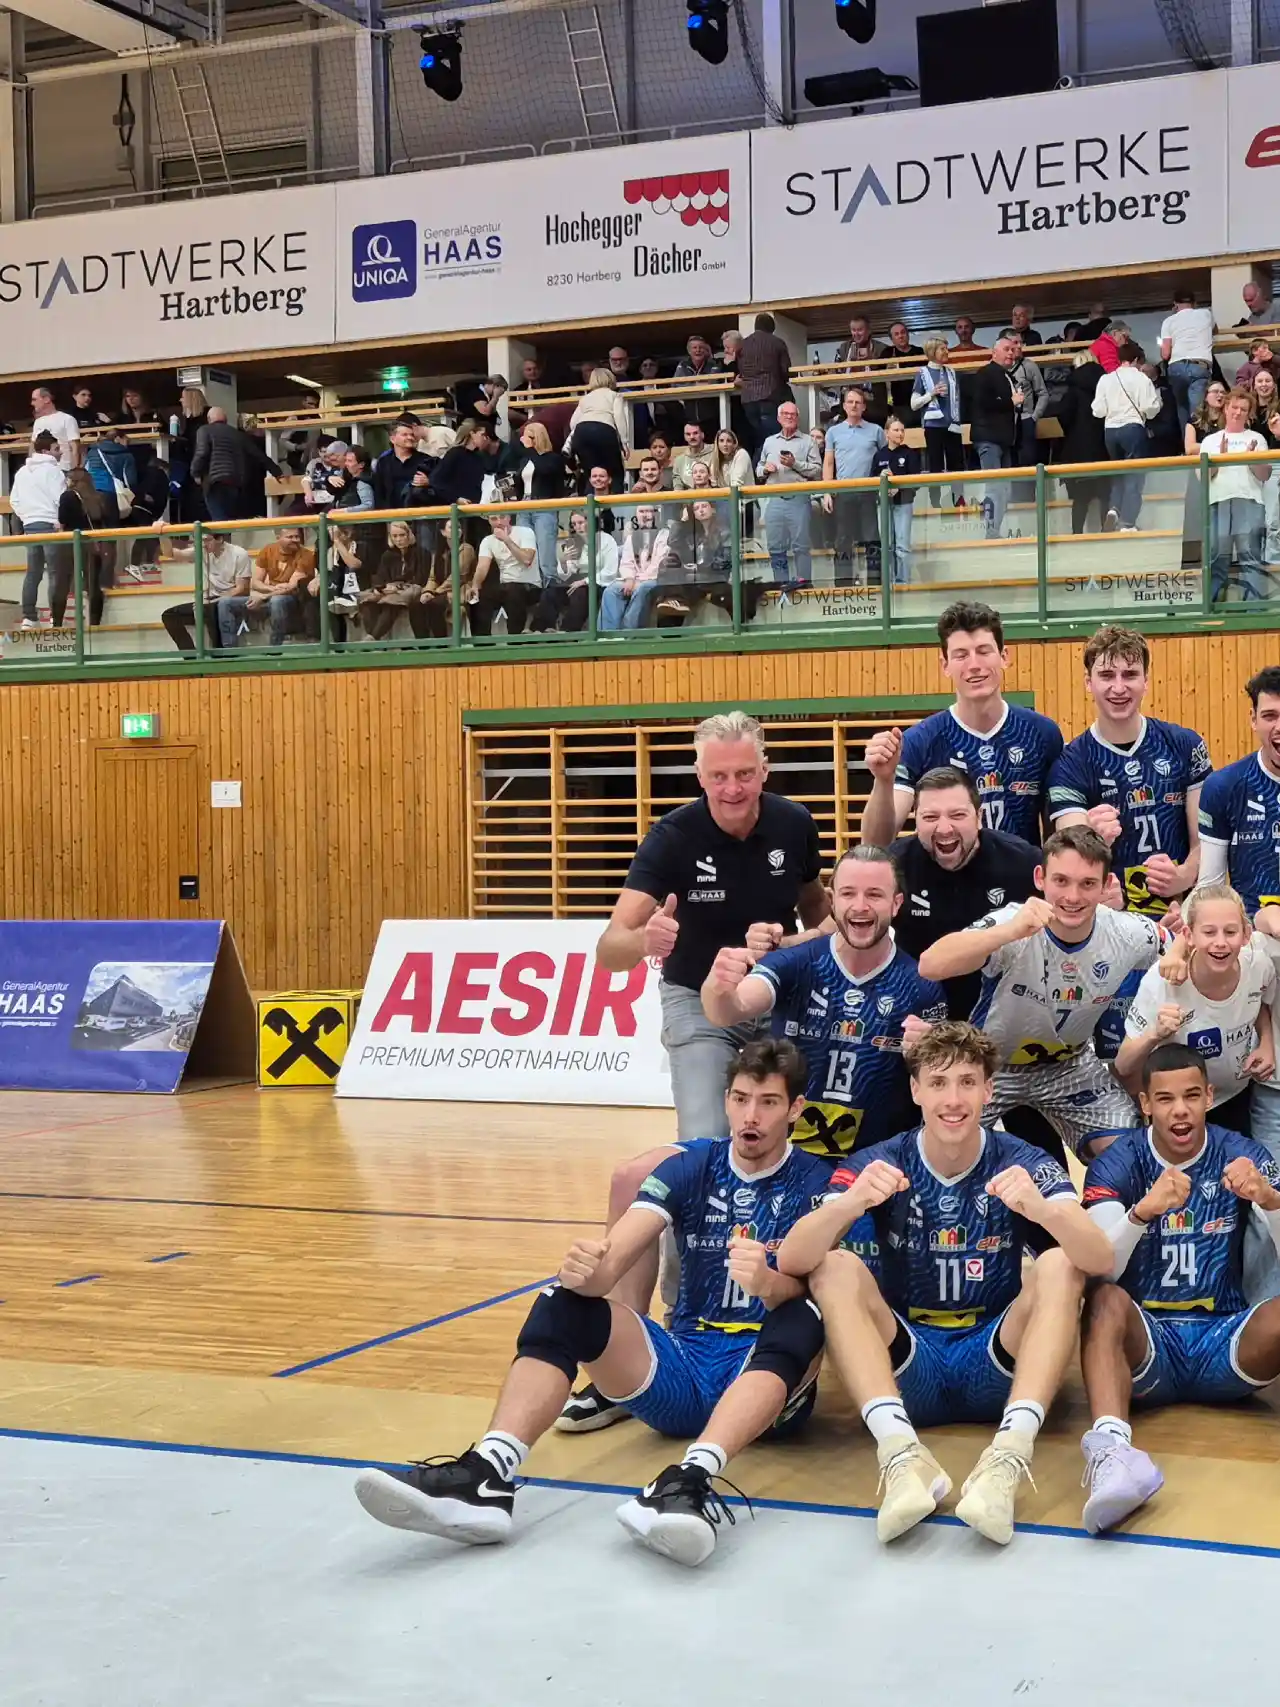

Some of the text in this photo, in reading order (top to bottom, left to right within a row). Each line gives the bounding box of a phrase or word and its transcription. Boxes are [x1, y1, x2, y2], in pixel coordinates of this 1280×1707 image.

[785, 126, 1190, 223] STADTWERKE
[997, 190, 1190, 234] Hartberg
[424, 223, 501, 240] GeneralAgentur
[545, 211, 643, 249] Hochegger
[424, 236, 502, 266] HAAS
[634, 243, 726, 277] Dächer GmbH
[0, 231, 308, 309] STADTWERKE
[353, 267, 409, 287] UNIQA
[547, 270, 621, 286] 8230 Hartberg
[159, 286, 307, 321] Hartberg
[1064, 571, 1194, 592] STADTWERKE
[1134, 590, 1194, 601] Hartberg
[822, 604, 877, 615] Hartberg
[1134, 814, 1162, 852] 21
[701, 891, 726, 899] HAAS
[911, 909, 930, 917] nine
[3, 980, 70, 992] GeneralAgentur
[370, 951, 649, 1036] AESIR
[0, 993, 65, 1014] HAAS
[807, 1007, 827, 1017] nine
[1055, 1009, 1072, 1033] 7
[1226, 1025, 1251, 1043] HAA
[360, 1046, 630, 1071] PREMIUM SPORTNAHRUNG
[826, 1050, 857, 1093] 13
[705, 1214, 728, 1223] nine
[695, 1239, 724, 1248] HAAS
[1161, 1243, 1198, 1287] 24
[935, 1258, 961, 1301] 11
